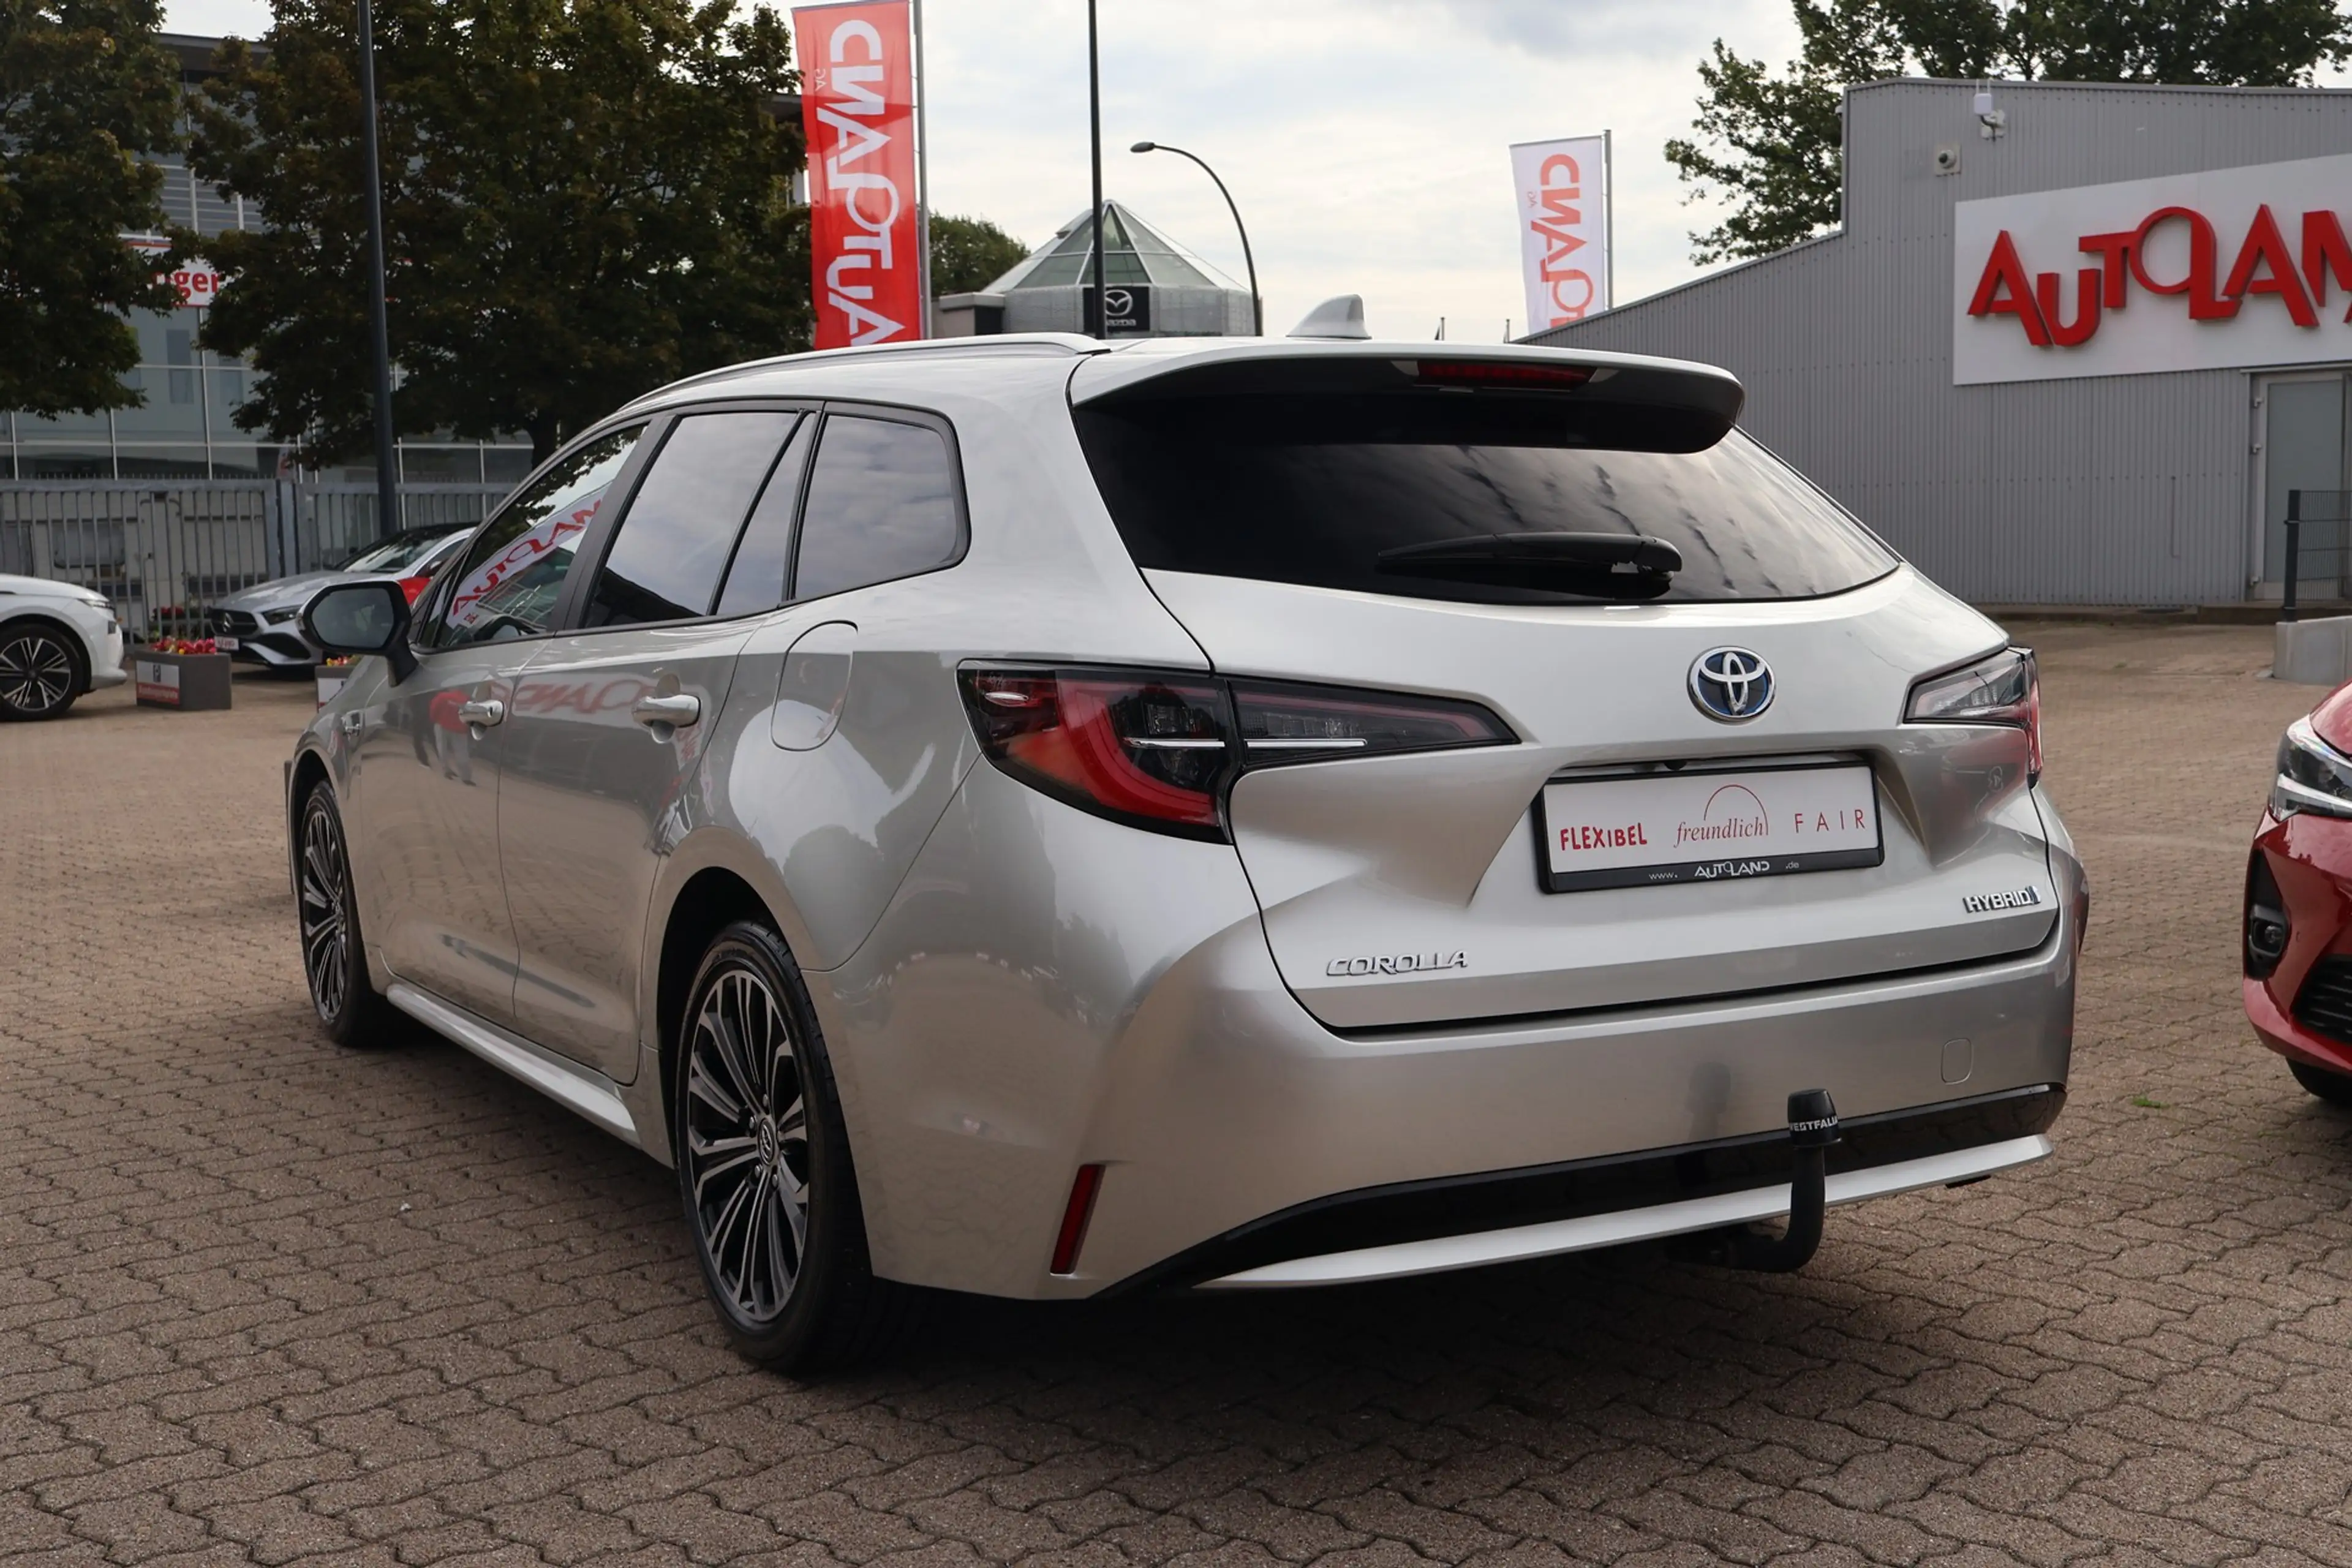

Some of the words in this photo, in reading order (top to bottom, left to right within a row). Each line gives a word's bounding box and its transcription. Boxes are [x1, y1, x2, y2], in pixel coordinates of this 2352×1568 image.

[1967, 203, 2352, 347] AUTOLAN
[1559, 822, 1648, 851] FLEXIBEL
[1673, 816, 1765, 848] freundlich
[1794, 809, 1866, 834] FAIR
[1694, 861, 1770, 879] AUTOLAND
[1963, 891, 2033, 913] HYBRID
[1326, 949, 1468, 976] COROLLA
